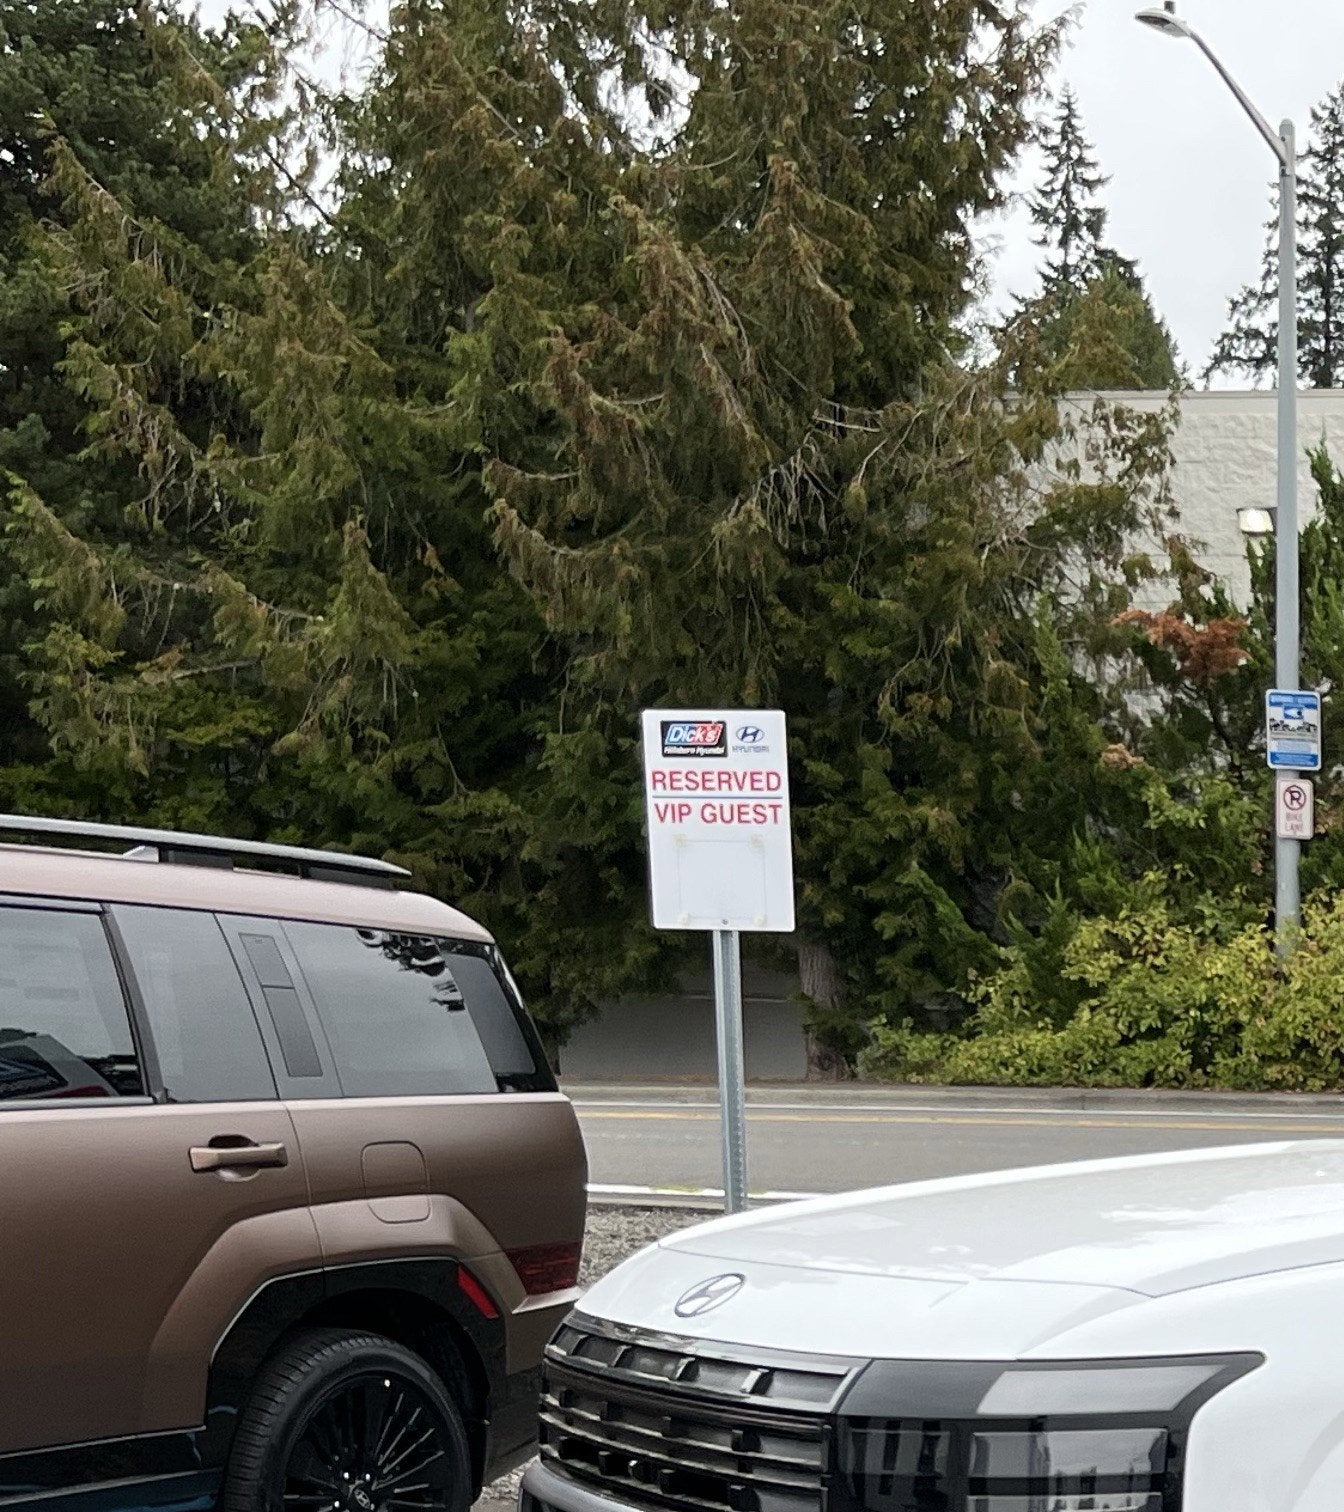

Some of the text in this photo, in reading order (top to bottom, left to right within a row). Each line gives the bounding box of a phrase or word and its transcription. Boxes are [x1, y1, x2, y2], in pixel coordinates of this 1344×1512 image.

[652, 771, 781, 792] RESERVED
[654, 803, 782, 825] VIP GUEST
